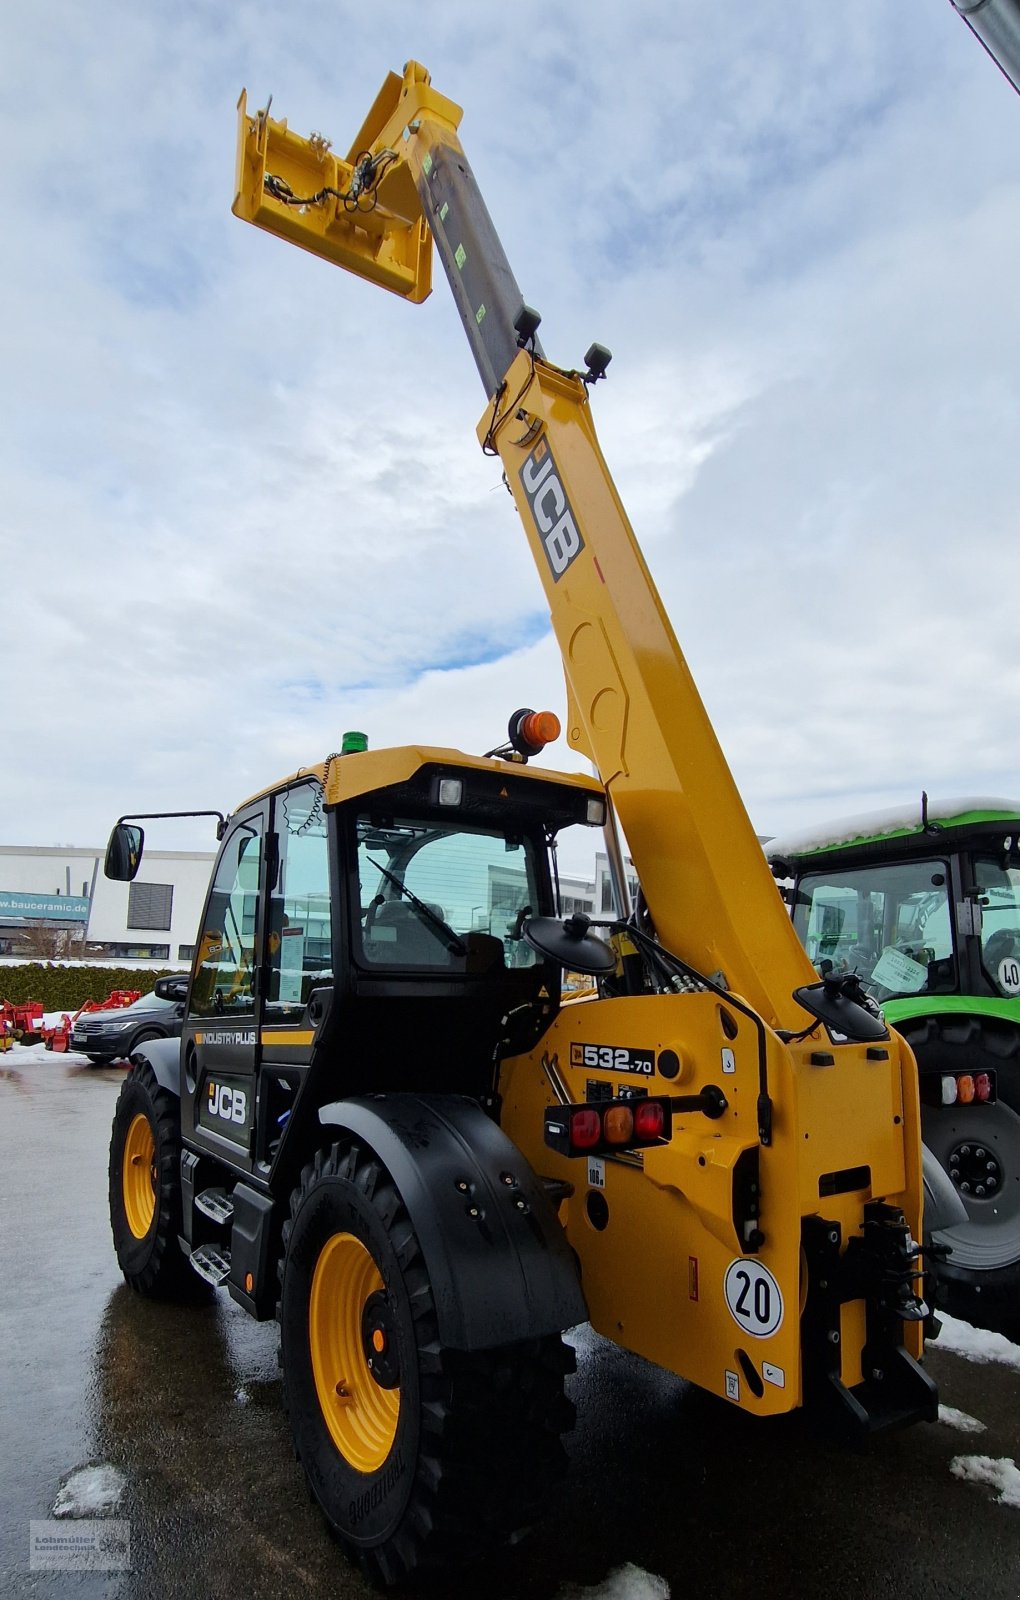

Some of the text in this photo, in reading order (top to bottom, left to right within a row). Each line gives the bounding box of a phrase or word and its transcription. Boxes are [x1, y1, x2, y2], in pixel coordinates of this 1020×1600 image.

[523, 458, 579, 573] JCB
[1004, 964, 1019, 986] 40
[208, 1084, 246, 1124] JCB
[735, 1270, 770, 1324] 20
